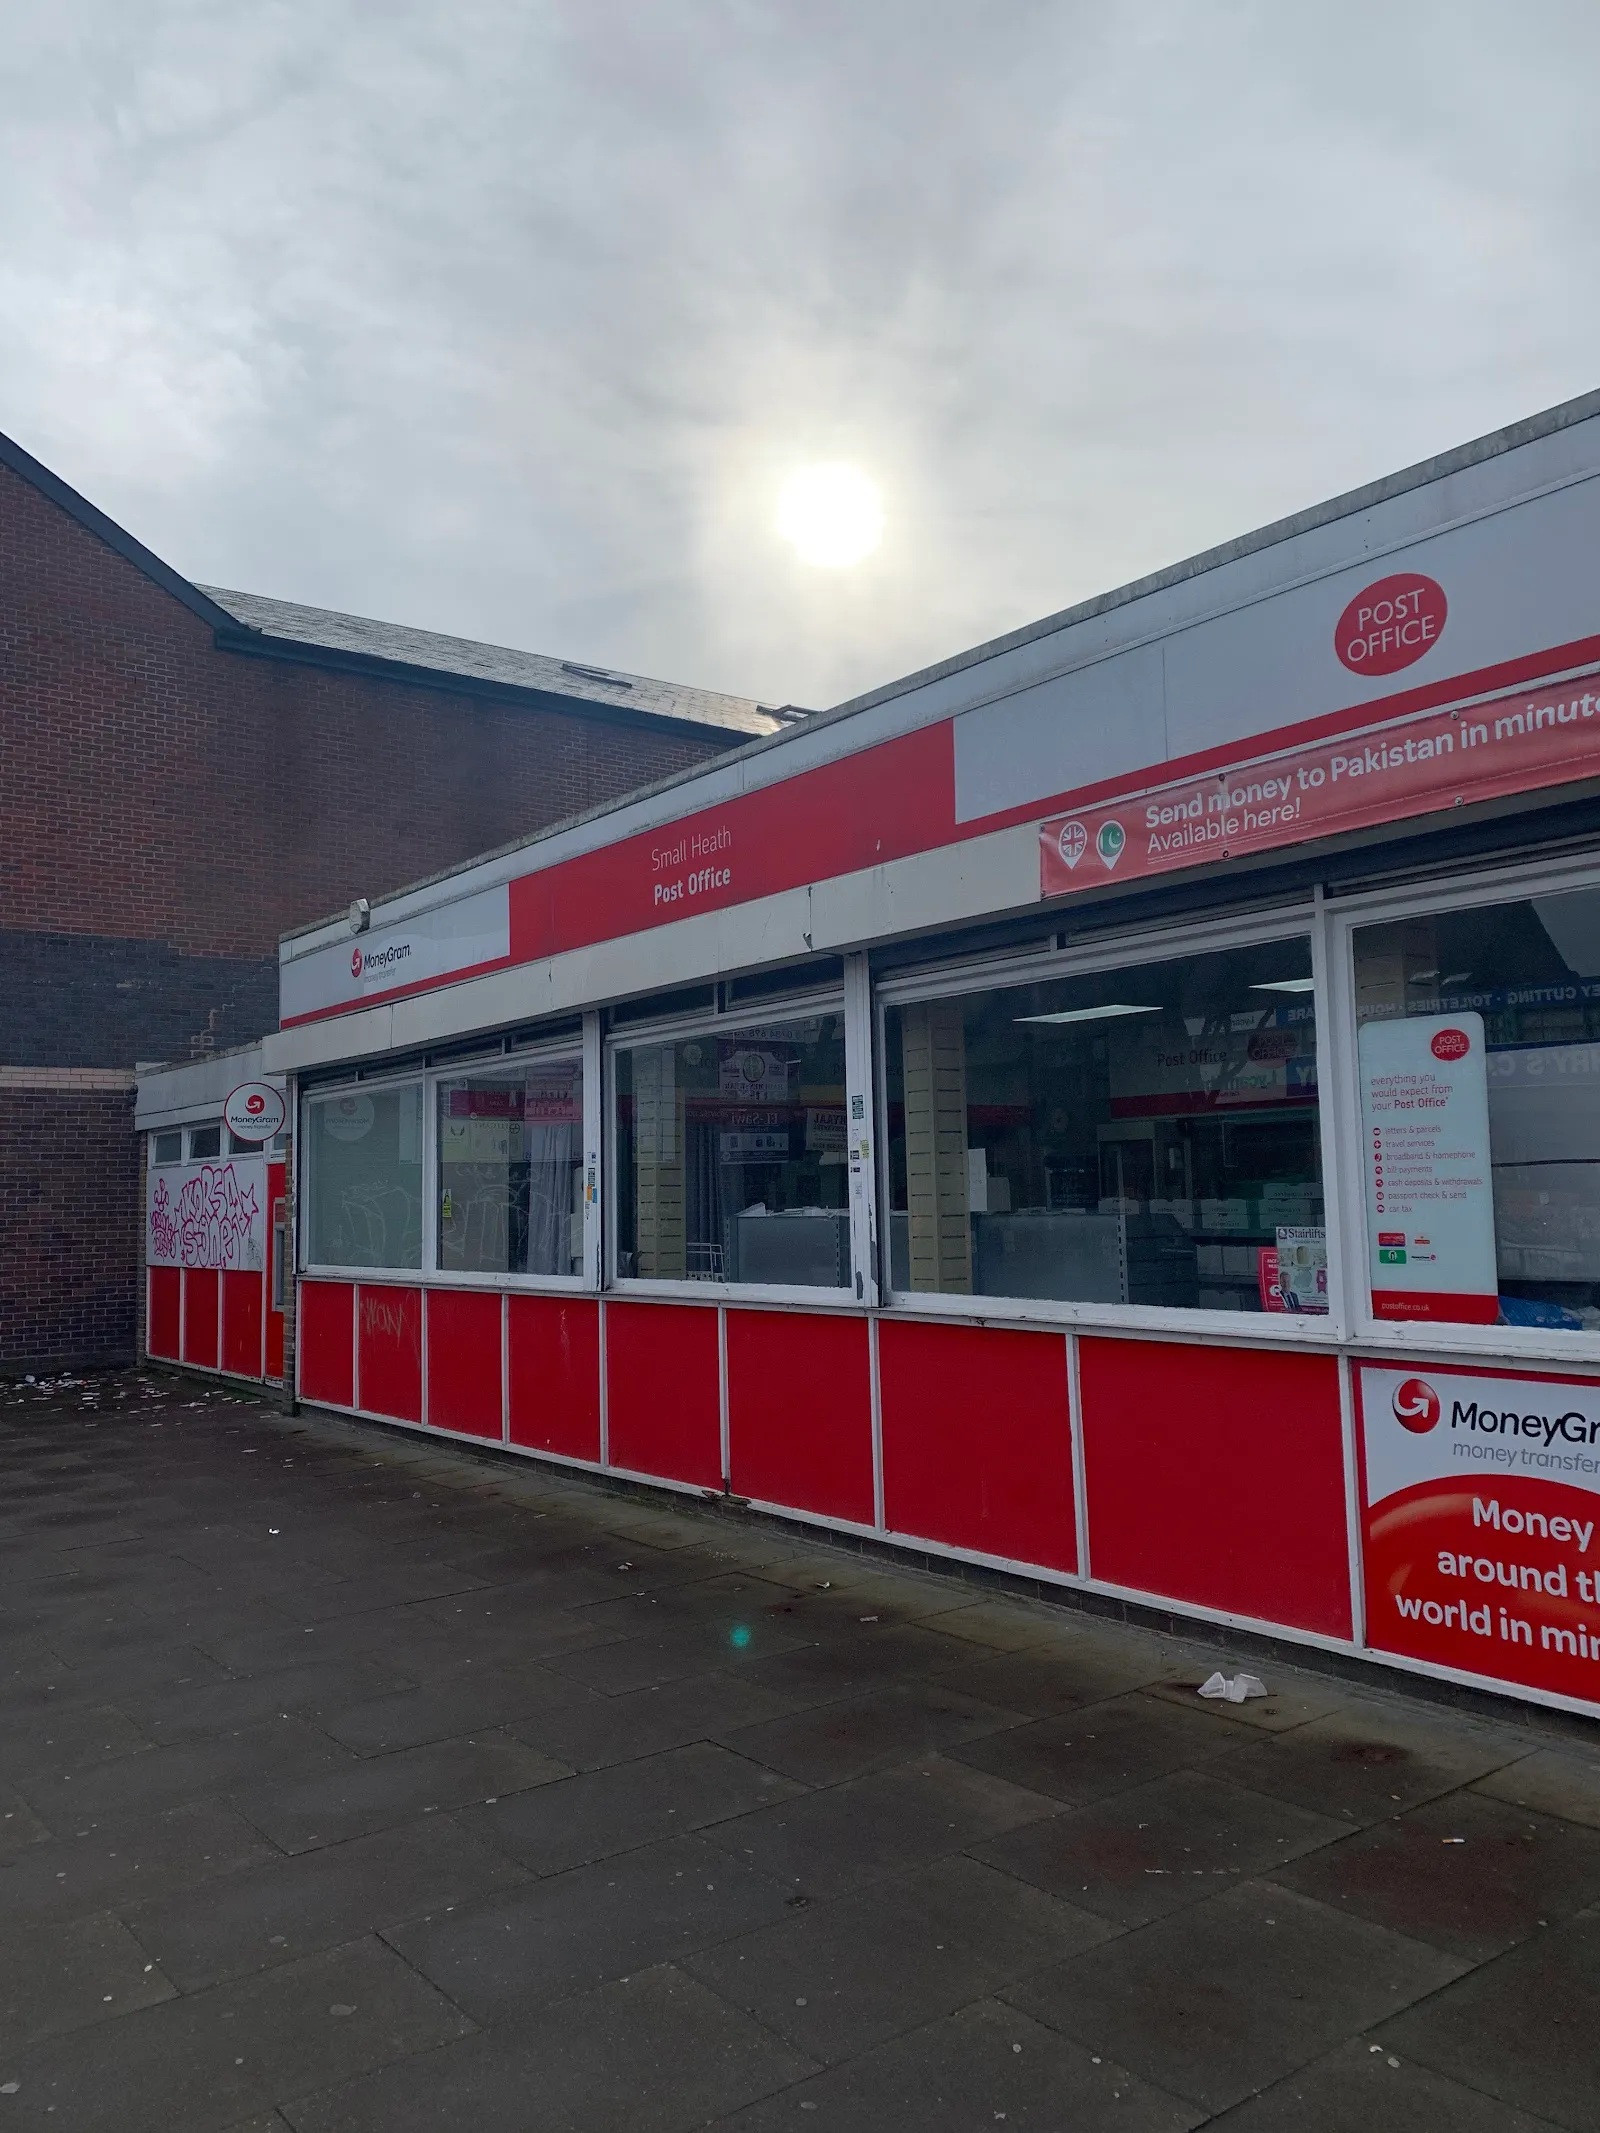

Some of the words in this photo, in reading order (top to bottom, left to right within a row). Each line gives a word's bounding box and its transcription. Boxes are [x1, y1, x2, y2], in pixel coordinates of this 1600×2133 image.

[1358, 588, 1425, 632] POST
[1348, 614, 1435, 662] OFFICE
[1146, 792, 1202, 828] Send
[1208, 774, 1292, 813] money
[1297, 765, 1325, 792] to
[1330, 730, 1453, 781] Pakistan
[1460, 716, 1488, 749] in
[1147, 816, 1239, 855] Available
[1244, 797, 1301, 831] here!
[651, 839, 686, 871] Small
[691, 825, 732, 858] Heath
[654, 880, 684, 906] Post
[688, 866, 731, 895] Office
[363, 944, 411, 969] MoneyGram
[1439, 1035, 1462, 1044] POST
[1435, 1044, 1466, 1053] OFFICE
[1157, 1052, 1185, 1067] Post
[1189, 1048, 1227, 1065] Office
[1371, 1074, 1416, 1086] everything
[1419, 1074, 1436, 1084] you
[1371, 1088, 1397, 1098] would
[1400, 1086, 1429, 1097] expect
[1432, 1084, 1453, 1094] from
[1372, 1102, 1391, 1113] your
[1394, 1099, 1415, 1109] Post
[230, 1116, 279, 1125] MoneyGram
[1385, 1126, 1407, 1135] letters
[1416, 1125, 1441, 1134] parcels
[1386, 1140, 1405, 1148] travel
[1432, 1151, 1476, 1161] homephone
[1399, 1166, 1433, 1175] payments
[1405, 1178, 1432, 1187] deposits
[1435, 1178, 1440, 1186] &
[1442, 1177, 1483, 1186] withdrawals
[1388, 1192, 1418, 1201] passport
[1401, 1204, 1412, 1212] tax
[1288, 1228, 1326, 1239] Stairlifts
[1381, 1302, 1430, 1312] postoffice.co.uk
[1453, 1443, 1517, 1467] money
[1473, 1497, 1594, 1553] Money
[1437, 1551, 1567, 1597] around
[1395, 1594, 1492, 1637] world
[1499, 1607, 1533, 1647] in
